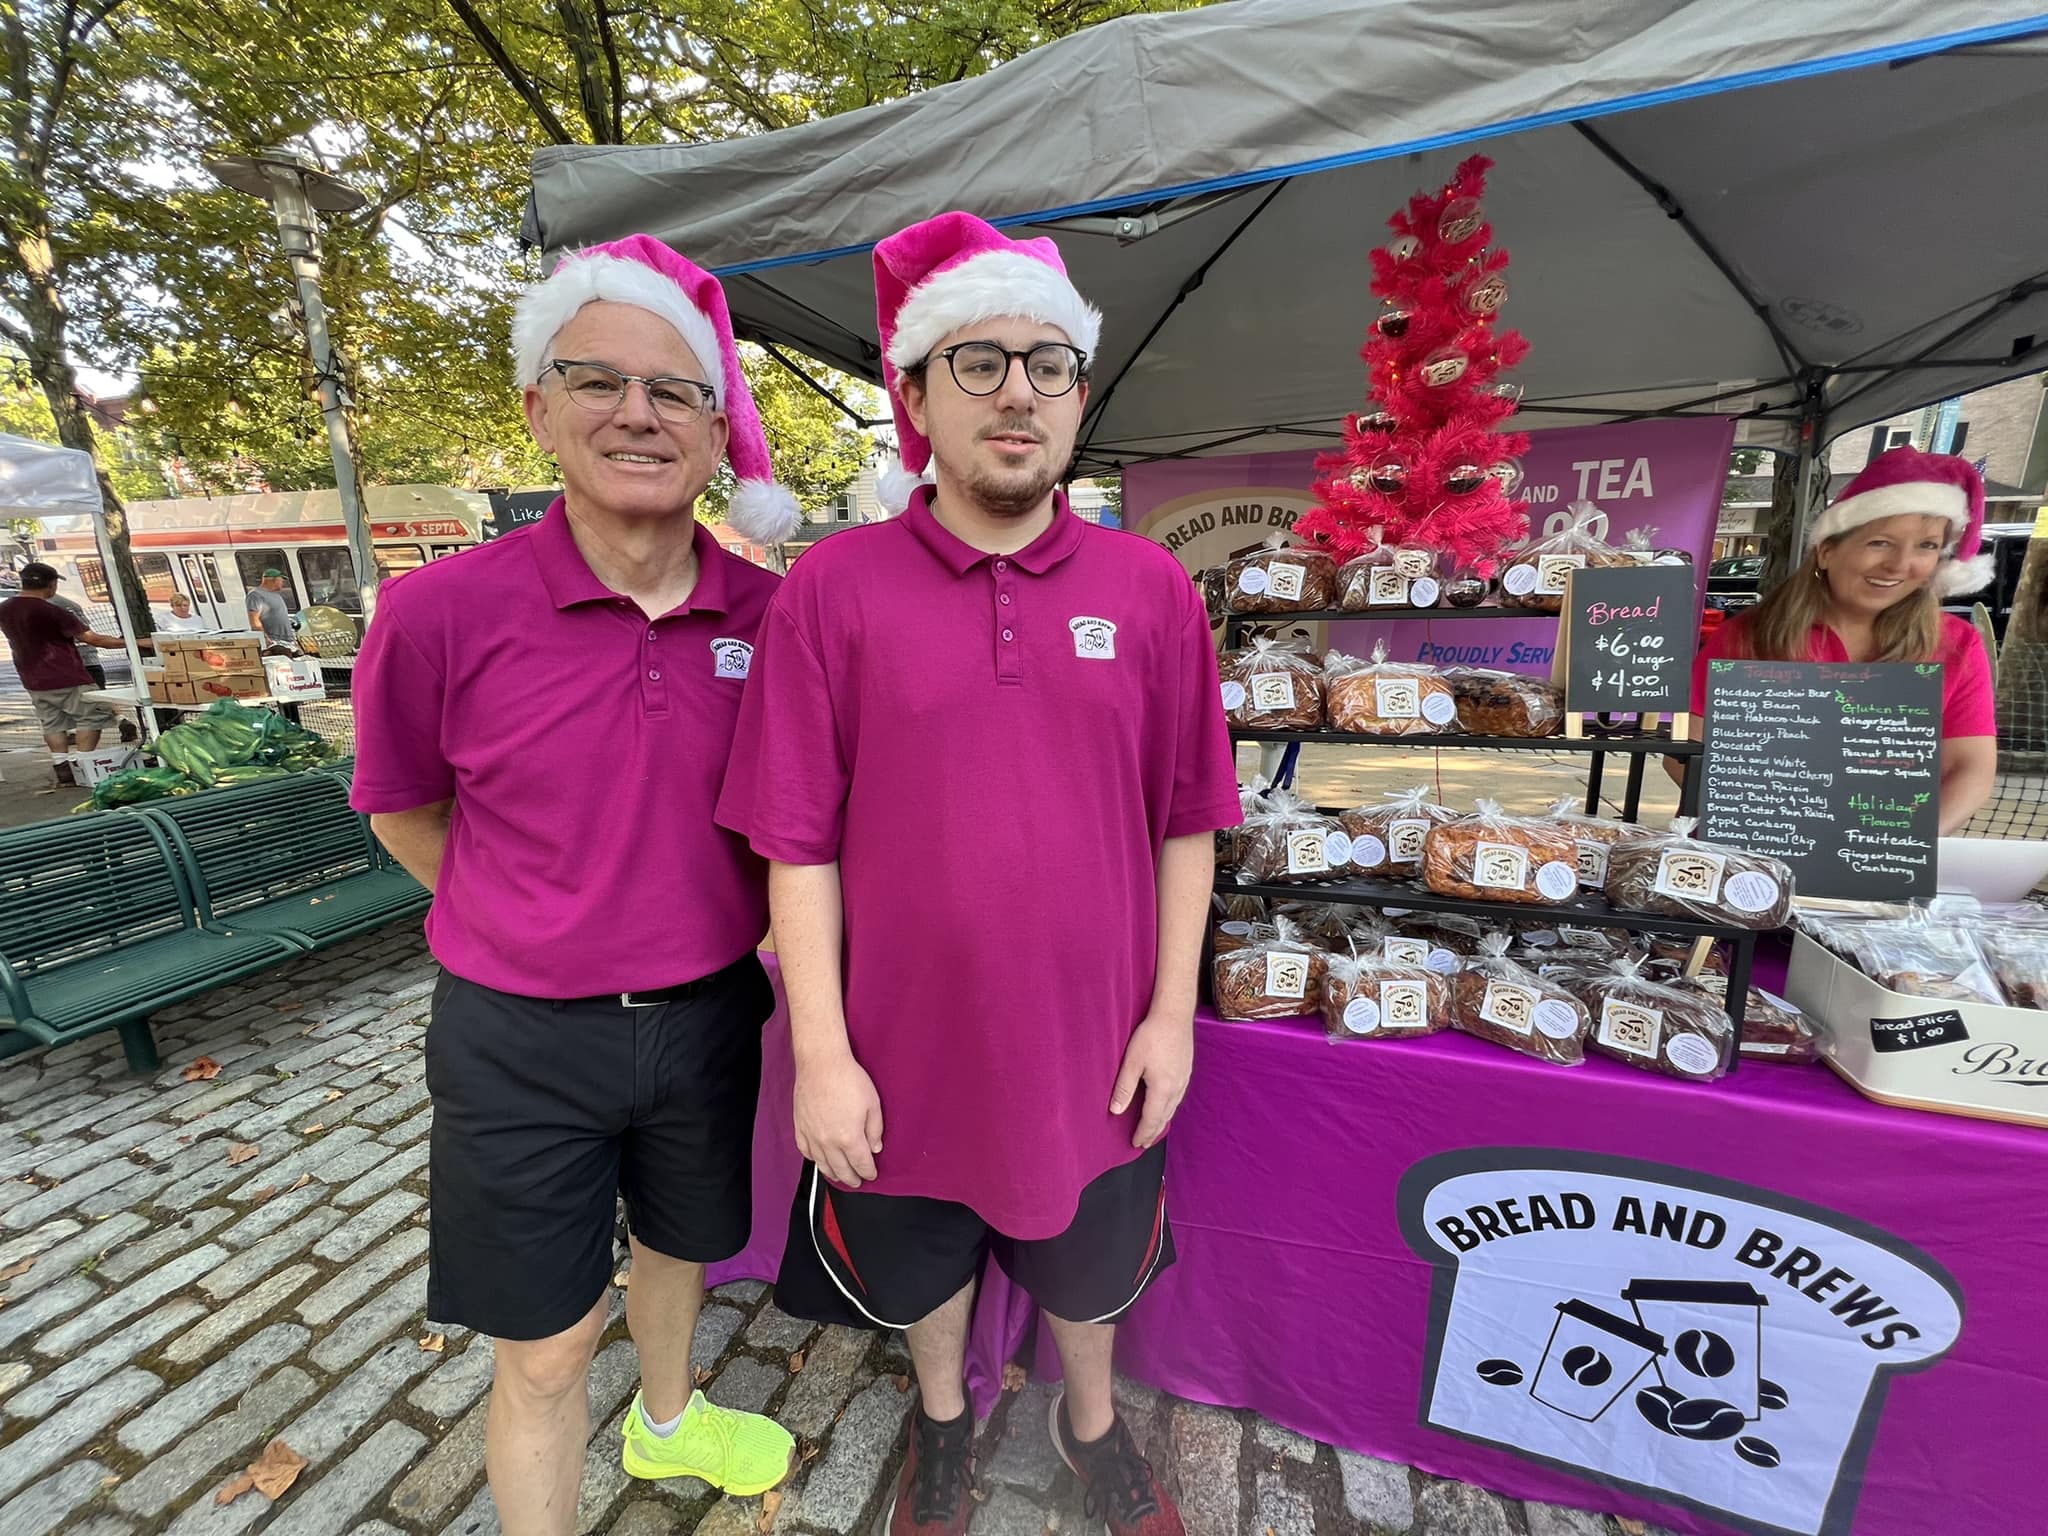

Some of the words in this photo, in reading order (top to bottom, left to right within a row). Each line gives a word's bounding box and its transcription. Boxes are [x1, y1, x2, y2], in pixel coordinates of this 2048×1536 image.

[1521, 485, 1558, 503] AND
[1572, 457, 1653, 500] TEA
[510, 508, 544, 522] Like
[1221, 504, 1263, 527] AND
[421, 523, 457, 535] SEPTA
[1587, 596, 1660, 625] Bread
[1595, 633, 1665, 657] $6.00
[1631, 654, 1674, 671] large
[1591, 669, 1659, 698] $4.00
[1631, 685, 1669, 697] small
[1714, 688, 1762, 697] Cheddar
[1762, 700, 1800, 710] Bacon
[1841, 703, 1892, 715] Gluten
[1897, 705, 1930, 715] Free
[1840, 717, 1908, 729] Gingerbread
[1712, 728, 1775, 744] Blueberry
[1776, 728, 1810, 739] Peach
[1843, 736, 1879, 744] Lemon
[1711, 740, 1763, 751] Chocolate
[1841, 748, 1881, 758] Peanut
[1709, 753, 1745, 762] Black
[1773, 755, 1807, 768] White
[1709, 764, 1760, 776] Chocolate
[1798, 770, 1833, 787] Cherry
[1845, 766, 1889, 775] Summer
[1708, 777, 1767, 790] Cinnamon
[1770, 781, 1809, 793] Raisin
[1746, 792, 1785, 804] Butter
[1798, 794, 1828, 809] Jelly
[1848, 793, 1917, 818] Holiday
[1707, 803, 1739, 813] Brown
[1739, 804, 1776, 815] Butter
[1802, 807, 1835, 821] Raisin
[1707, 815, 1741, 828] Apple
[1859, 814, 1910, 828] Flavors
[1707, 827, 1748, 840] Banana
[1792, 835, 1816, 850] Chip
[1844, 829, 1931, 848] Fruitcake
[1747, 844, 1808, 856] Lavender
[1837, 848, 1927, 864] Gingerbread
[1897, 1027, 1944, 1045] $1.00
[1434, 1191, 1598, 1254] BREAD
[1611, 1195, 1728, 1250] AND
[1733, 1226, 1922, 1352] BREWS
